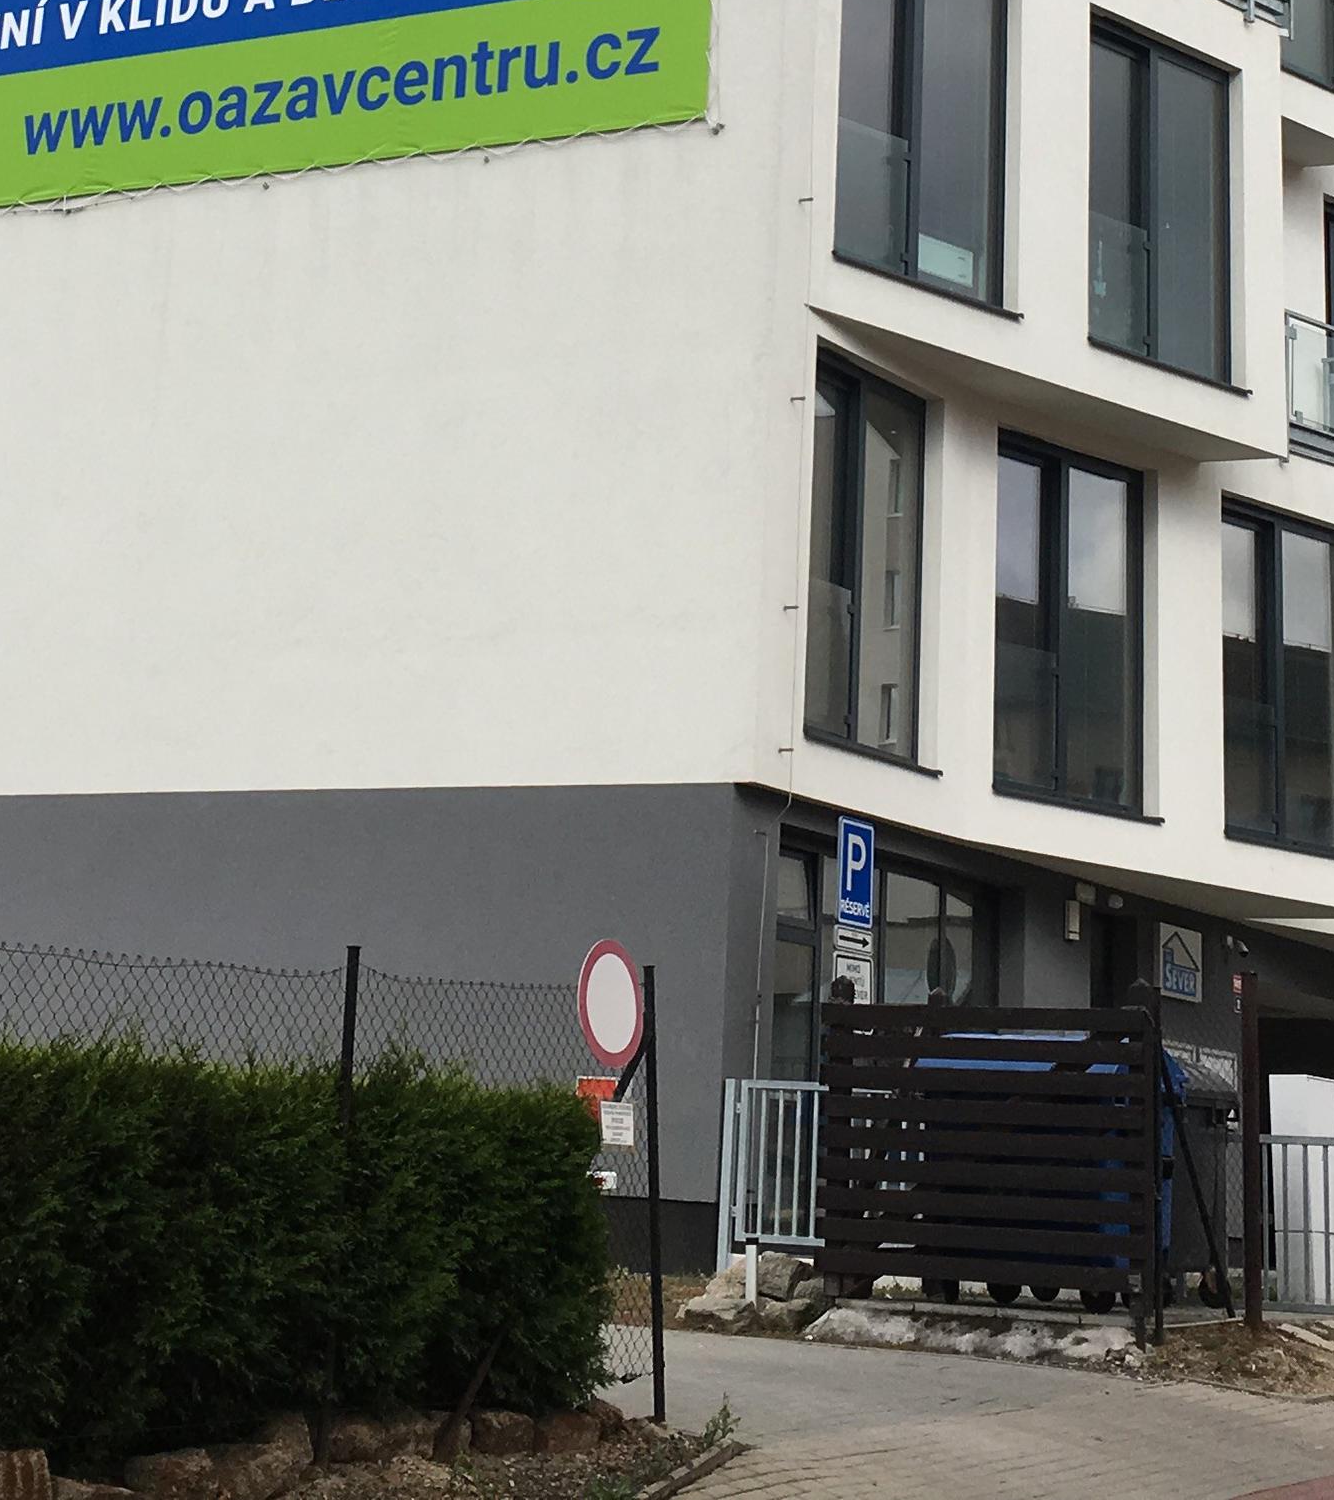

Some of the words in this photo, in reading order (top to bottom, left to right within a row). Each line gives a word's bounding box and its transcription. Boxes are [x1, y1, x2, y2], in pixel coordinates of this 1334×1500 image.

[61, 0, 89, 40] V
[23, 26, 662, 156] www.oazavcentru.cz
[846, 833, 867, 891] P
[1165, 962, 1196, 993] SEVER
